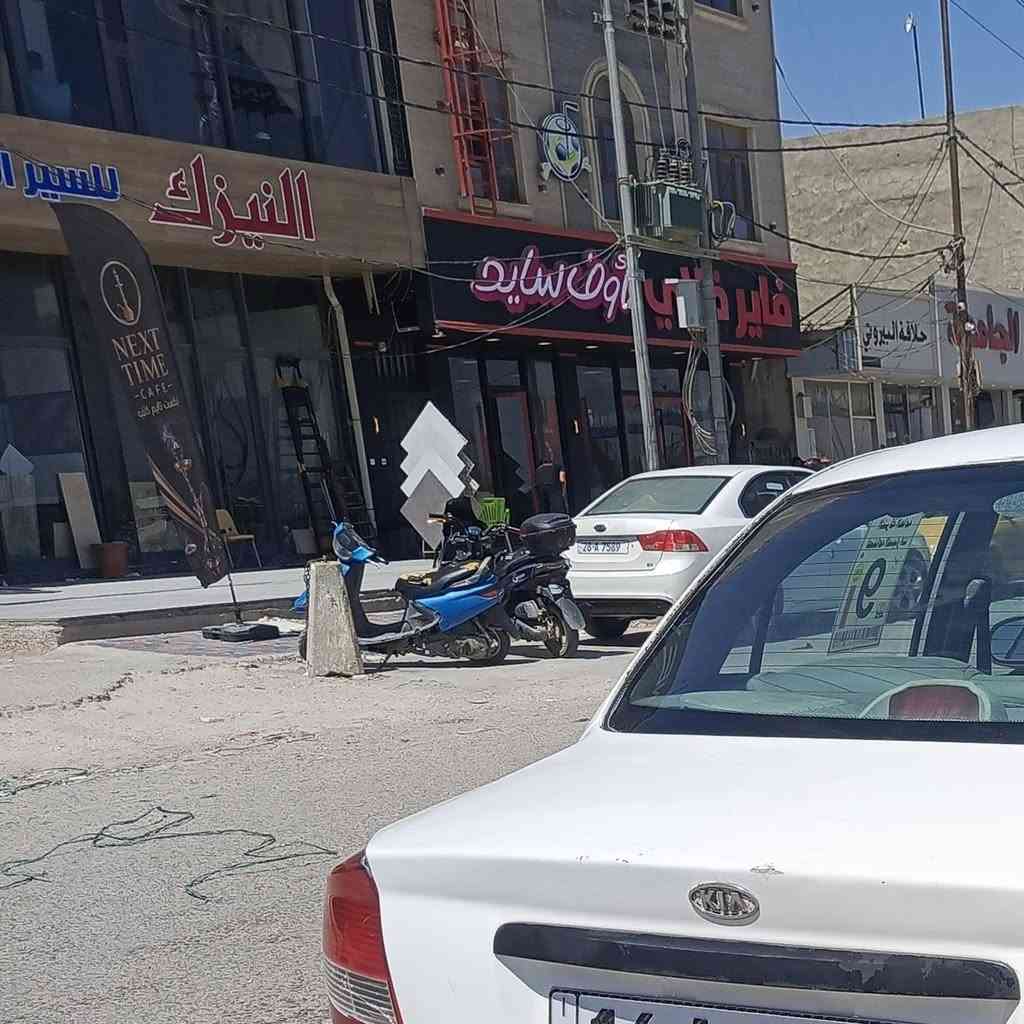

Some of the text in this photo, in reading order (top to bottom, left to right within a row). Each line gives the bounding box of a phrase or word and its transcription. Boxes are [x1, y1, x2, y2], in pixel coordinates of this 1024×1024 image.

[0, 149, 317, 250] النيزك للسيرا
[472, 247, 565, 306] سايد
[736, 271, 793, 337] فاير
[112, 327, 161, 361] NEXT
[900, 320, 927, 343] حلاقة
[121, 353, 169, 386] TIME
